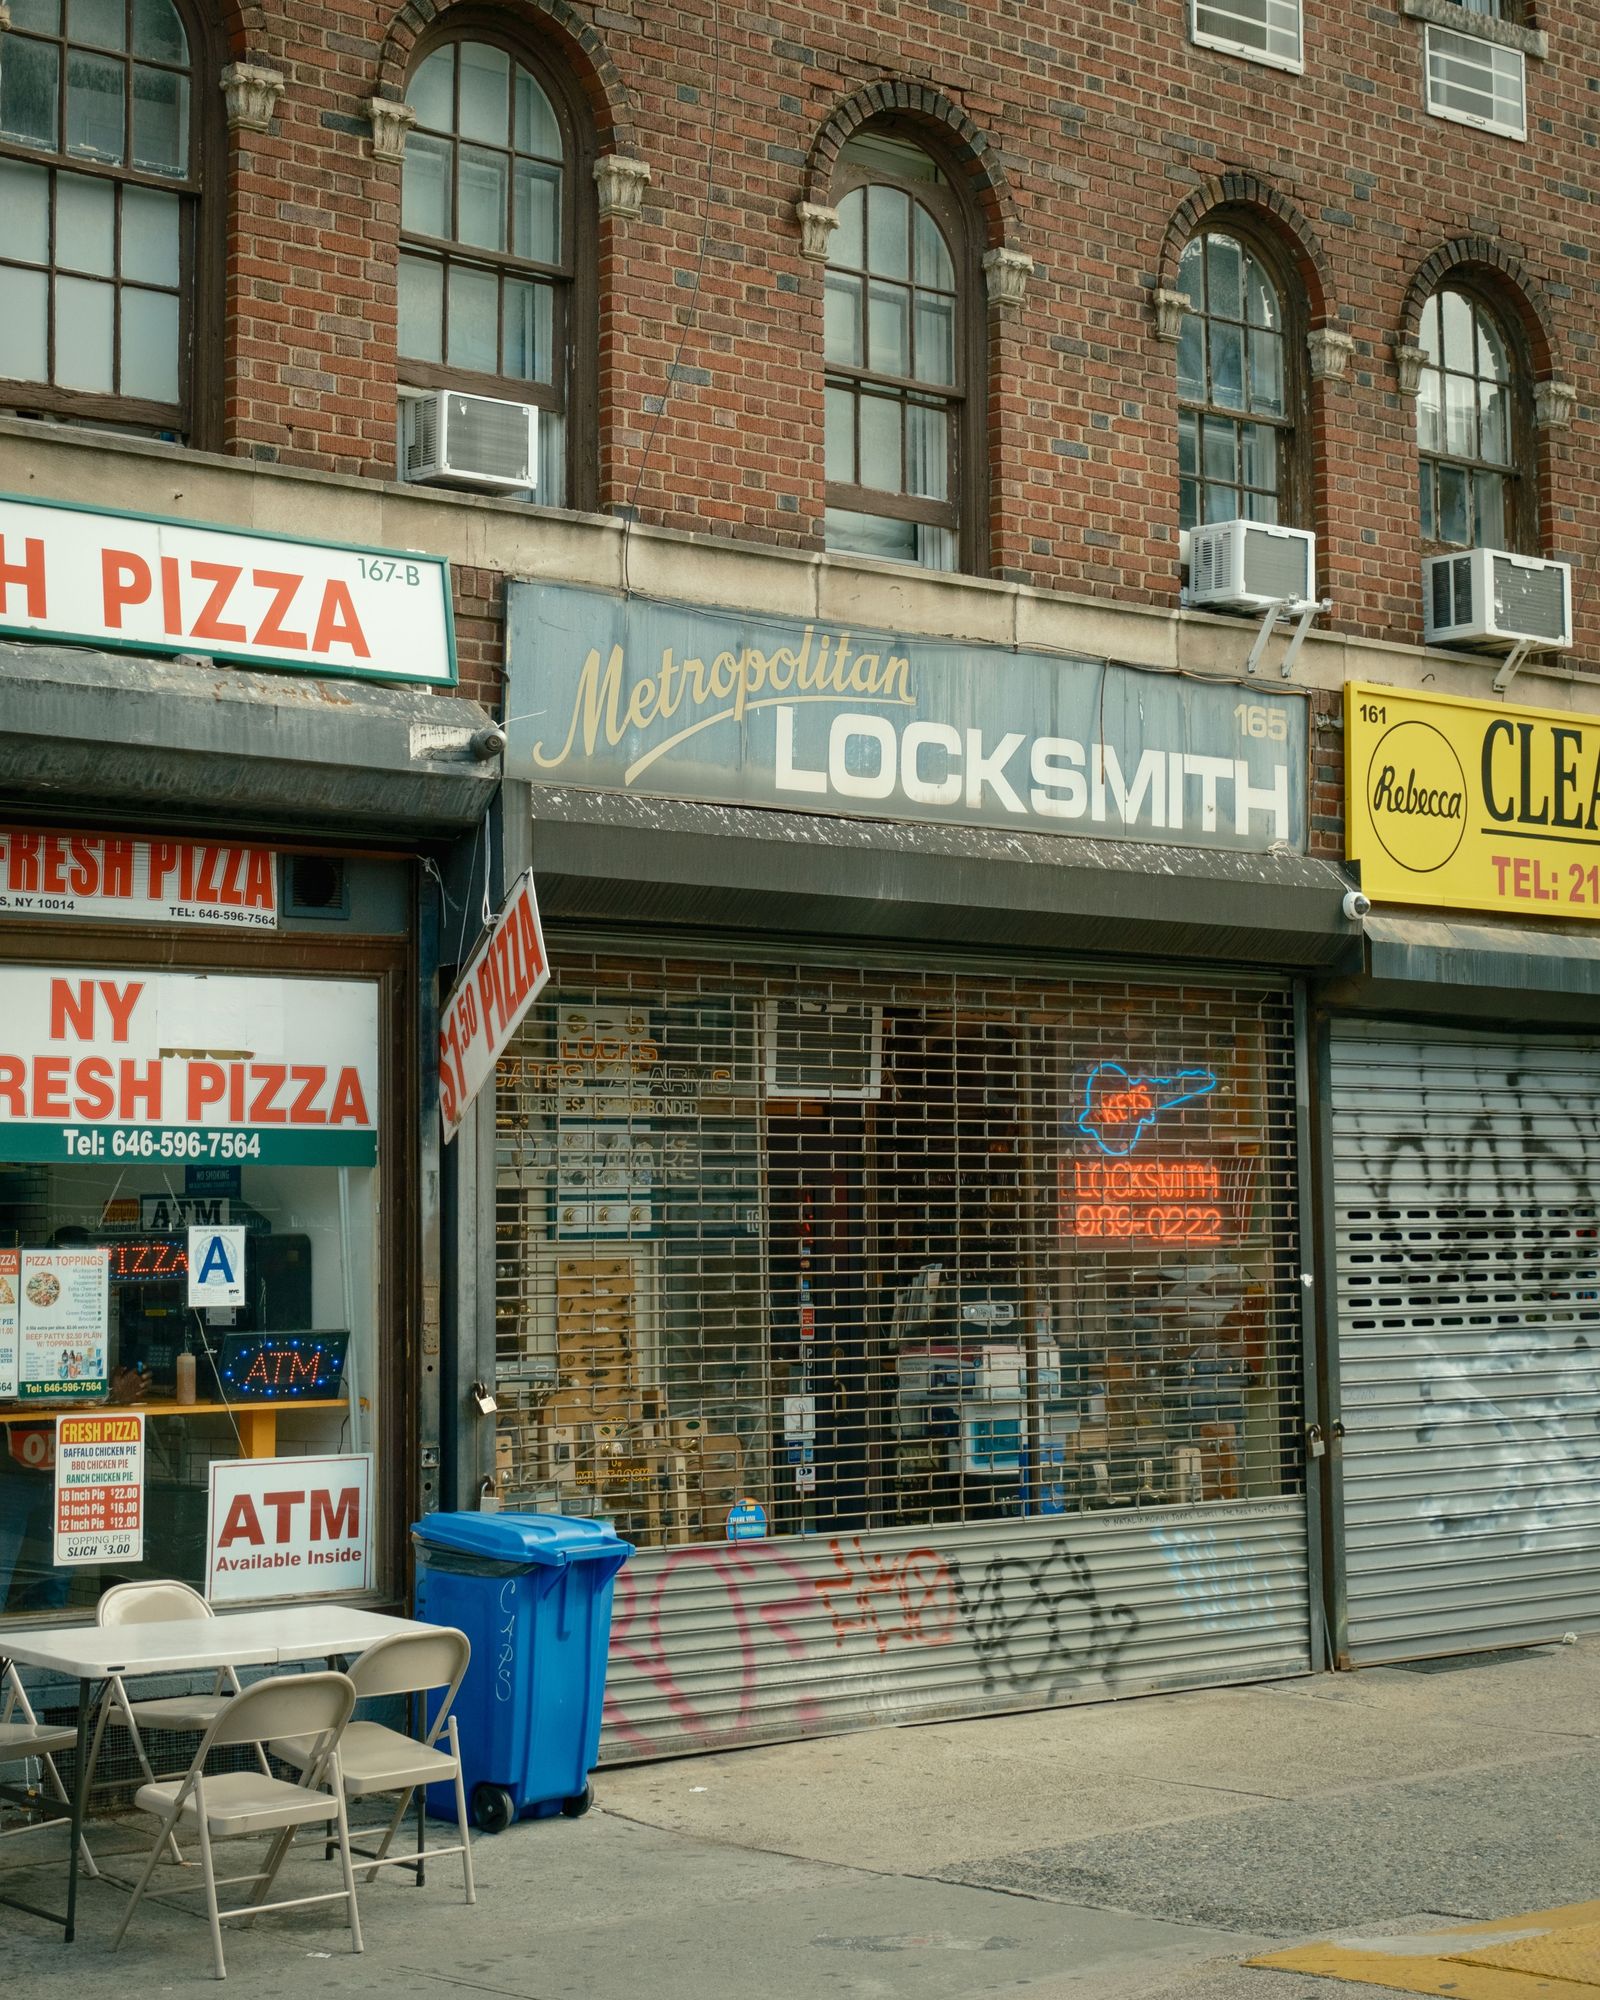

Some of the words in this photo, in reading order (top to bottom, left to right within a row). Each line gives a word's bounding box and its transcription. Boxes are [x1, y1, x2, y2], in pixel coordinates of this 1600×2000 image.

[357, 557, 421, 587] 167-B
[101, 548, 371, 658] PIZZA
[533, 625, 915, 768] Metropolitan
[1233, 703, 1288, 742] 165
[1360, 704, 1387, 724] 161
[776, 706, 1290, 840] LOCKSMITH
[1374, 765, 1462, 819] Rebecca
[0, 833, 133, 899] RESH
[148, 842, 275, 911] PIZZA
[1492, 856, 1558, 900] TEL:
[15, 898, 35, 908] NY
[37, 899, 75, 911] 10014
[169, 907, 195, 918] TEL:
[198, 908, 276, 926] 646-596-7564
[477, 888, 543, 1055] PIZZA
[50, 977, 146, 1043] NY
[559, 1036, 658, 1062] LOCKS
[186, 1061, 371, 1126] PIZZA
[63, 1129, 105, 1156] Tel:
[111, 1130, 260, 1159] 646-596-7564
[1075, 1163, 1218, 1198] LOCKSMITH
[151, 1200, 222, 1226] ATM
[26, 1256, 52, 1266] PIZZA
[56, 1254, 104, 1266] TOPPINGS
[198, 1236, 235, 1284] A
[244, 1352, 321, 1385] ATM
[26, 1384, 42, 1393] Tel:
[44, 1382, 102, 1392] 646-596-7564
[62, 1422, 100, 1443] FRESH
[104, 1421, 138, 1441] PIZZA
[63, 1447, 94, 1458] BAFFALO
[95, 1446, 124, 1457] CHICKEN
[126, 1445, 137, 1455] PIE
[72, 1461, 86, 1470] BBQ
[87, 1460, 116, 1470] CHICKEN
[118, 1459, 128, 1469] PIE
[66, 1474, 90, 1484] RANCH
[91, 1472, 121, 1483] CHICKEN
[122, 1472, 133, 1481] PIE
[61, 1490, 70, 1502] 18
[71, 1489, 90, 1501] Inch
[91, 1488, 105, 1500] Pie
[110, 1488, 138, 1500] $22.00
[61, 1505, 70, 1517] 16
[71, 1504, 90, 1516] Inch
[91, 1503, 105, 1515] Pie
[110, 1502, 138, 1514] $16.00
[217, 1487, 361, 1549] ATM
[61, 1519, 69, 1531] 12
[70, 1518, 90, 1530] Inch
[91, 1518, 105, 1529] Pie
[110, 1516, 138, 1528] $12.00
[67, 1535, 109, 1546] TOPPING
[112, 1534, 131, 1543] PER
[67, 1545, 98, 1557] SLICH
[103, 1543, 130, 1555] $3.00
[216, 1553, 301, 1572] Available
[307, 1548, 362, 1565] Inside
